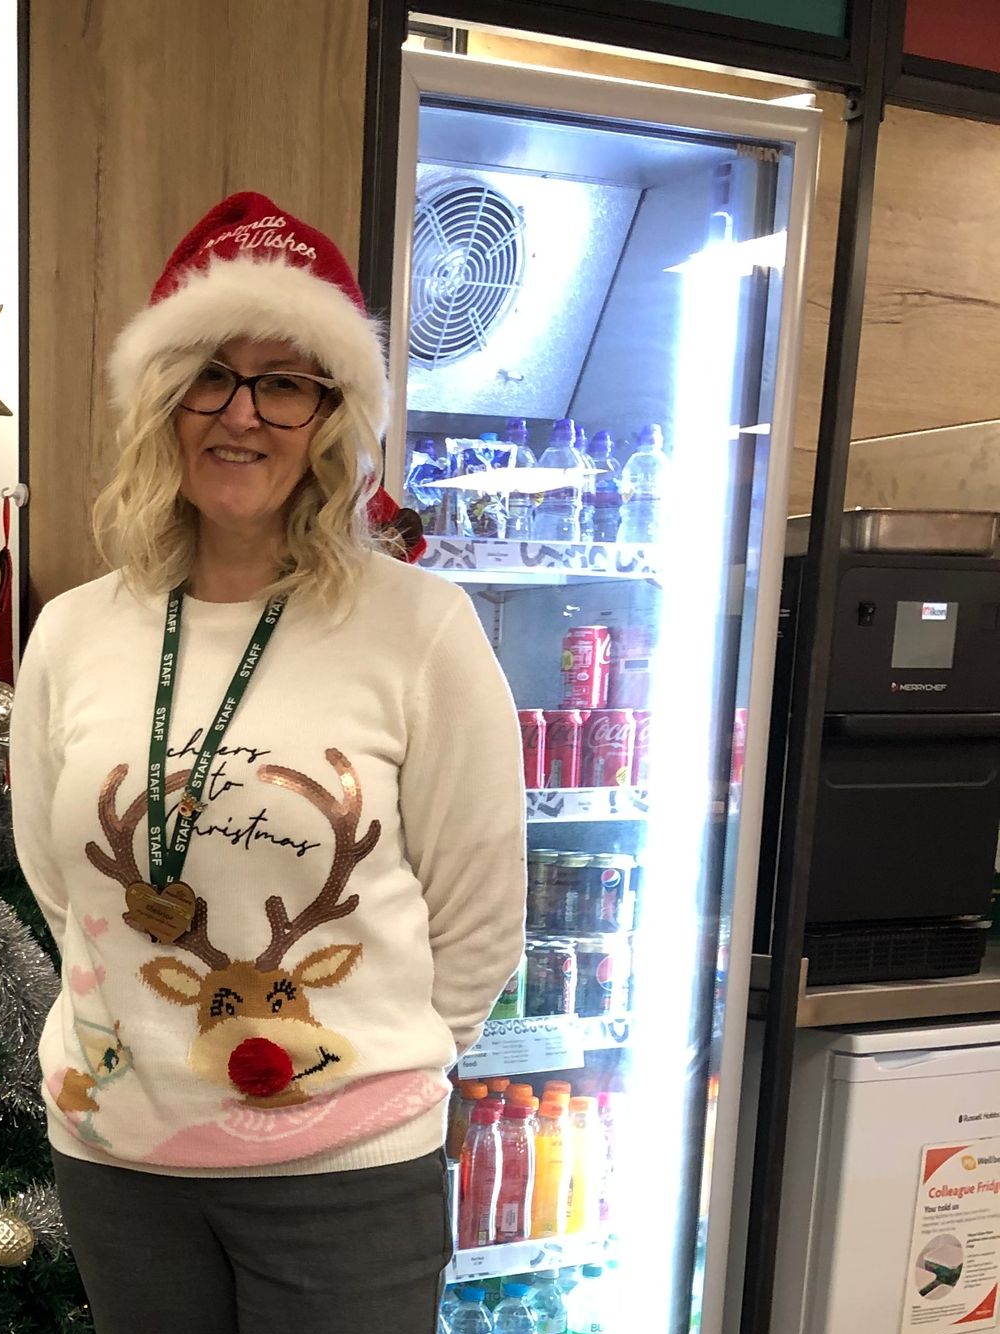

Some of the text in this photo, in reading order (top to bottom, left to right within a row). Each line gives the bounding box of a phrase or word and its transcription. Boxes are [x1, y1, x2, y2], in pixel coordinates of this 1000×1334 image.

[234, 228, 317, 260] Wishes
[166, 600, 179, 633] STAFF
[264, 600, 287, 625] STA
[160, 653, 174, 687] STAFF
[240, 643, 262, 678] STAFF
[153, 707, 167, 742] STAFF
[214, 697, 237, 731] STAFF
[167, 728, 271, 763] chers
[150, 763, 161, 802] STAFF
[191, 751, 212, 789] STAFF
[208, 761, 244, 801] to
[150, 826, 163, 867] STAFF
[928, 1180, 1000, 1199] Colleague Fridg
